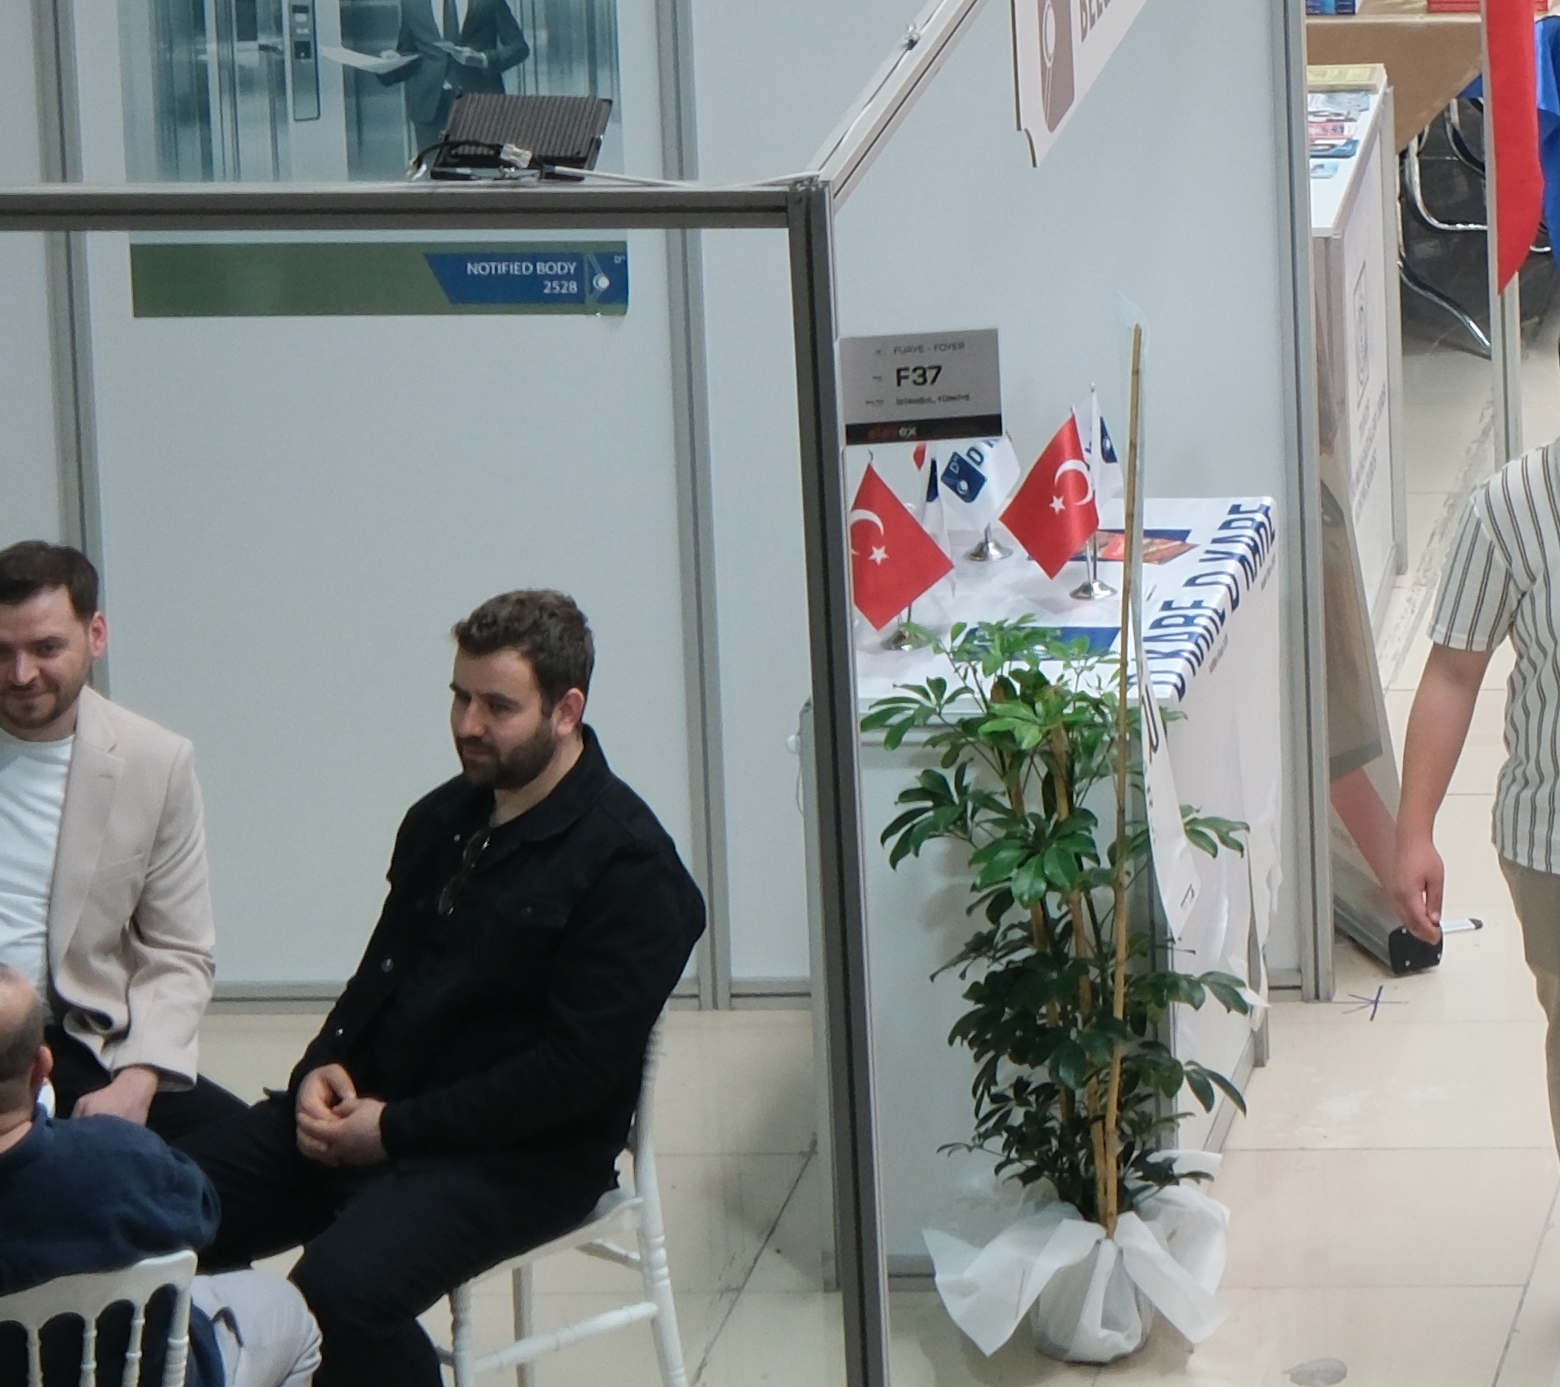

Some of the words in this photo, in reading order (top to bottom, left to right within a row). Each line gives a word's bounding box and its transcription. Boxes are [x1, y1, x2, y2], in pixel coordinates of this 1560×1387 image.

[467, 261, 534, 276] NOTIFIED
[537, 261, 577, 276] BODY
[933, 341, 966, 353] FOYER
[896, 364, 943, 387] F37
[1198, 503, 1277, 592] KARE
[1182, 570, 1241, 614] D
[1142, 599, 1227, 679] KARE
